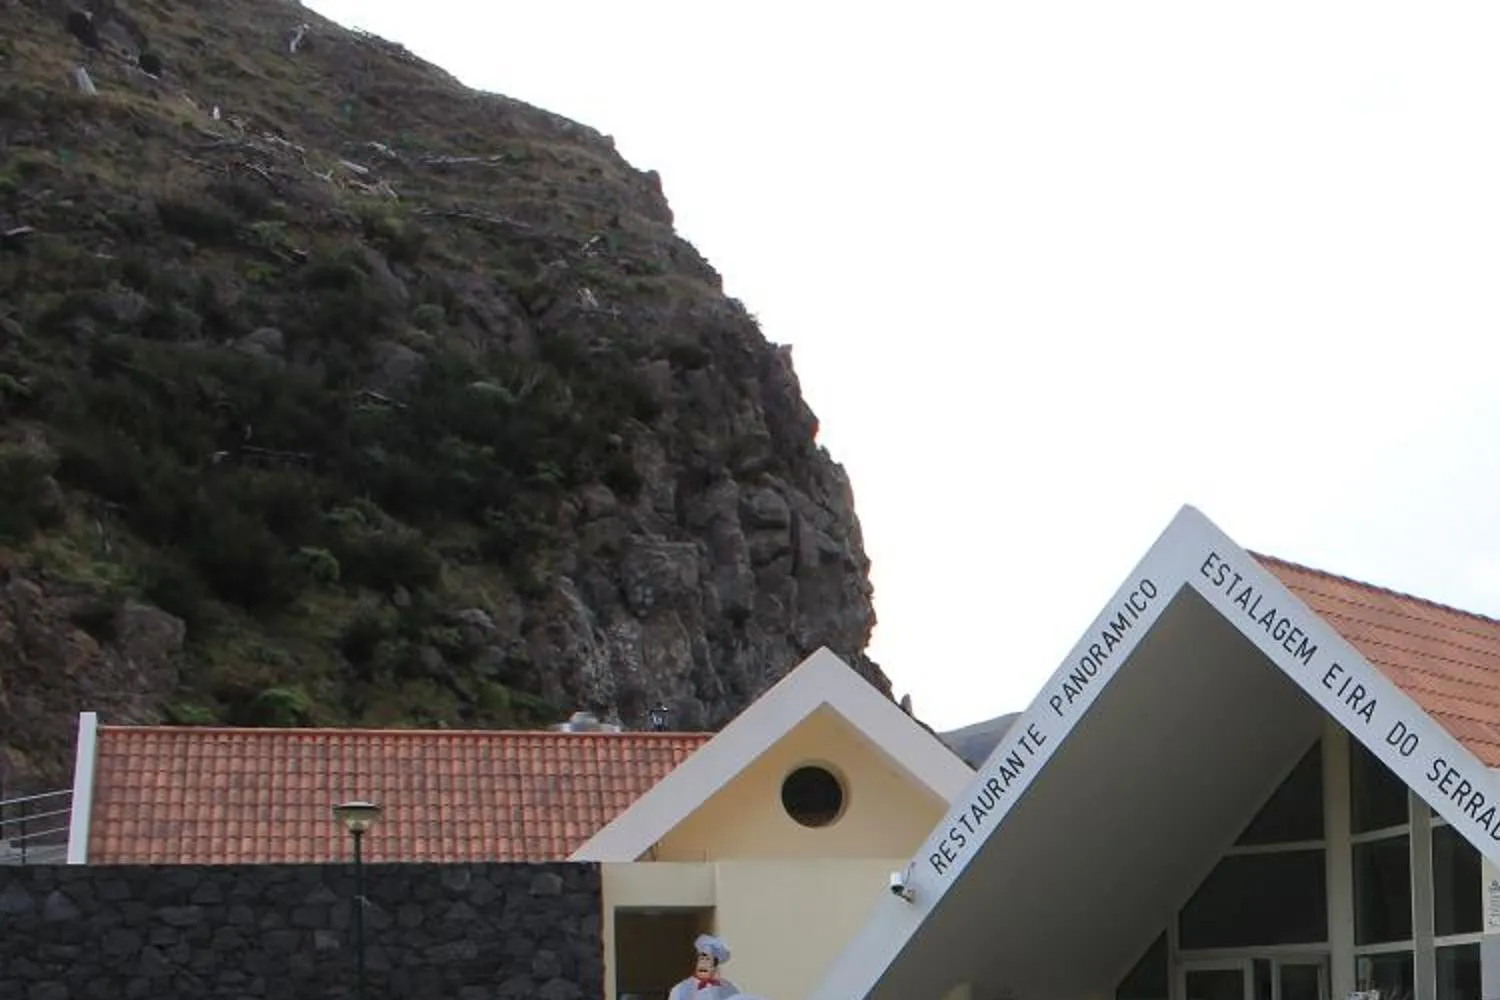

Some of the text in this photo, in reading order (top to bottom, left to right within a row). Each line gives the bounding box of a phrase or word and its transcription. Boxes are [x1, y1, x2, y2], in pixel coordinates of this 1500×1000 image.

[929, 578, 1158, 875] RESTAURANTE PANORAMICO
[1200, 552, 1318, 666] ESTALAGEM
[1321, 663, 1378, 724] EIRA
[1385, 721, 1420, 757] DO
